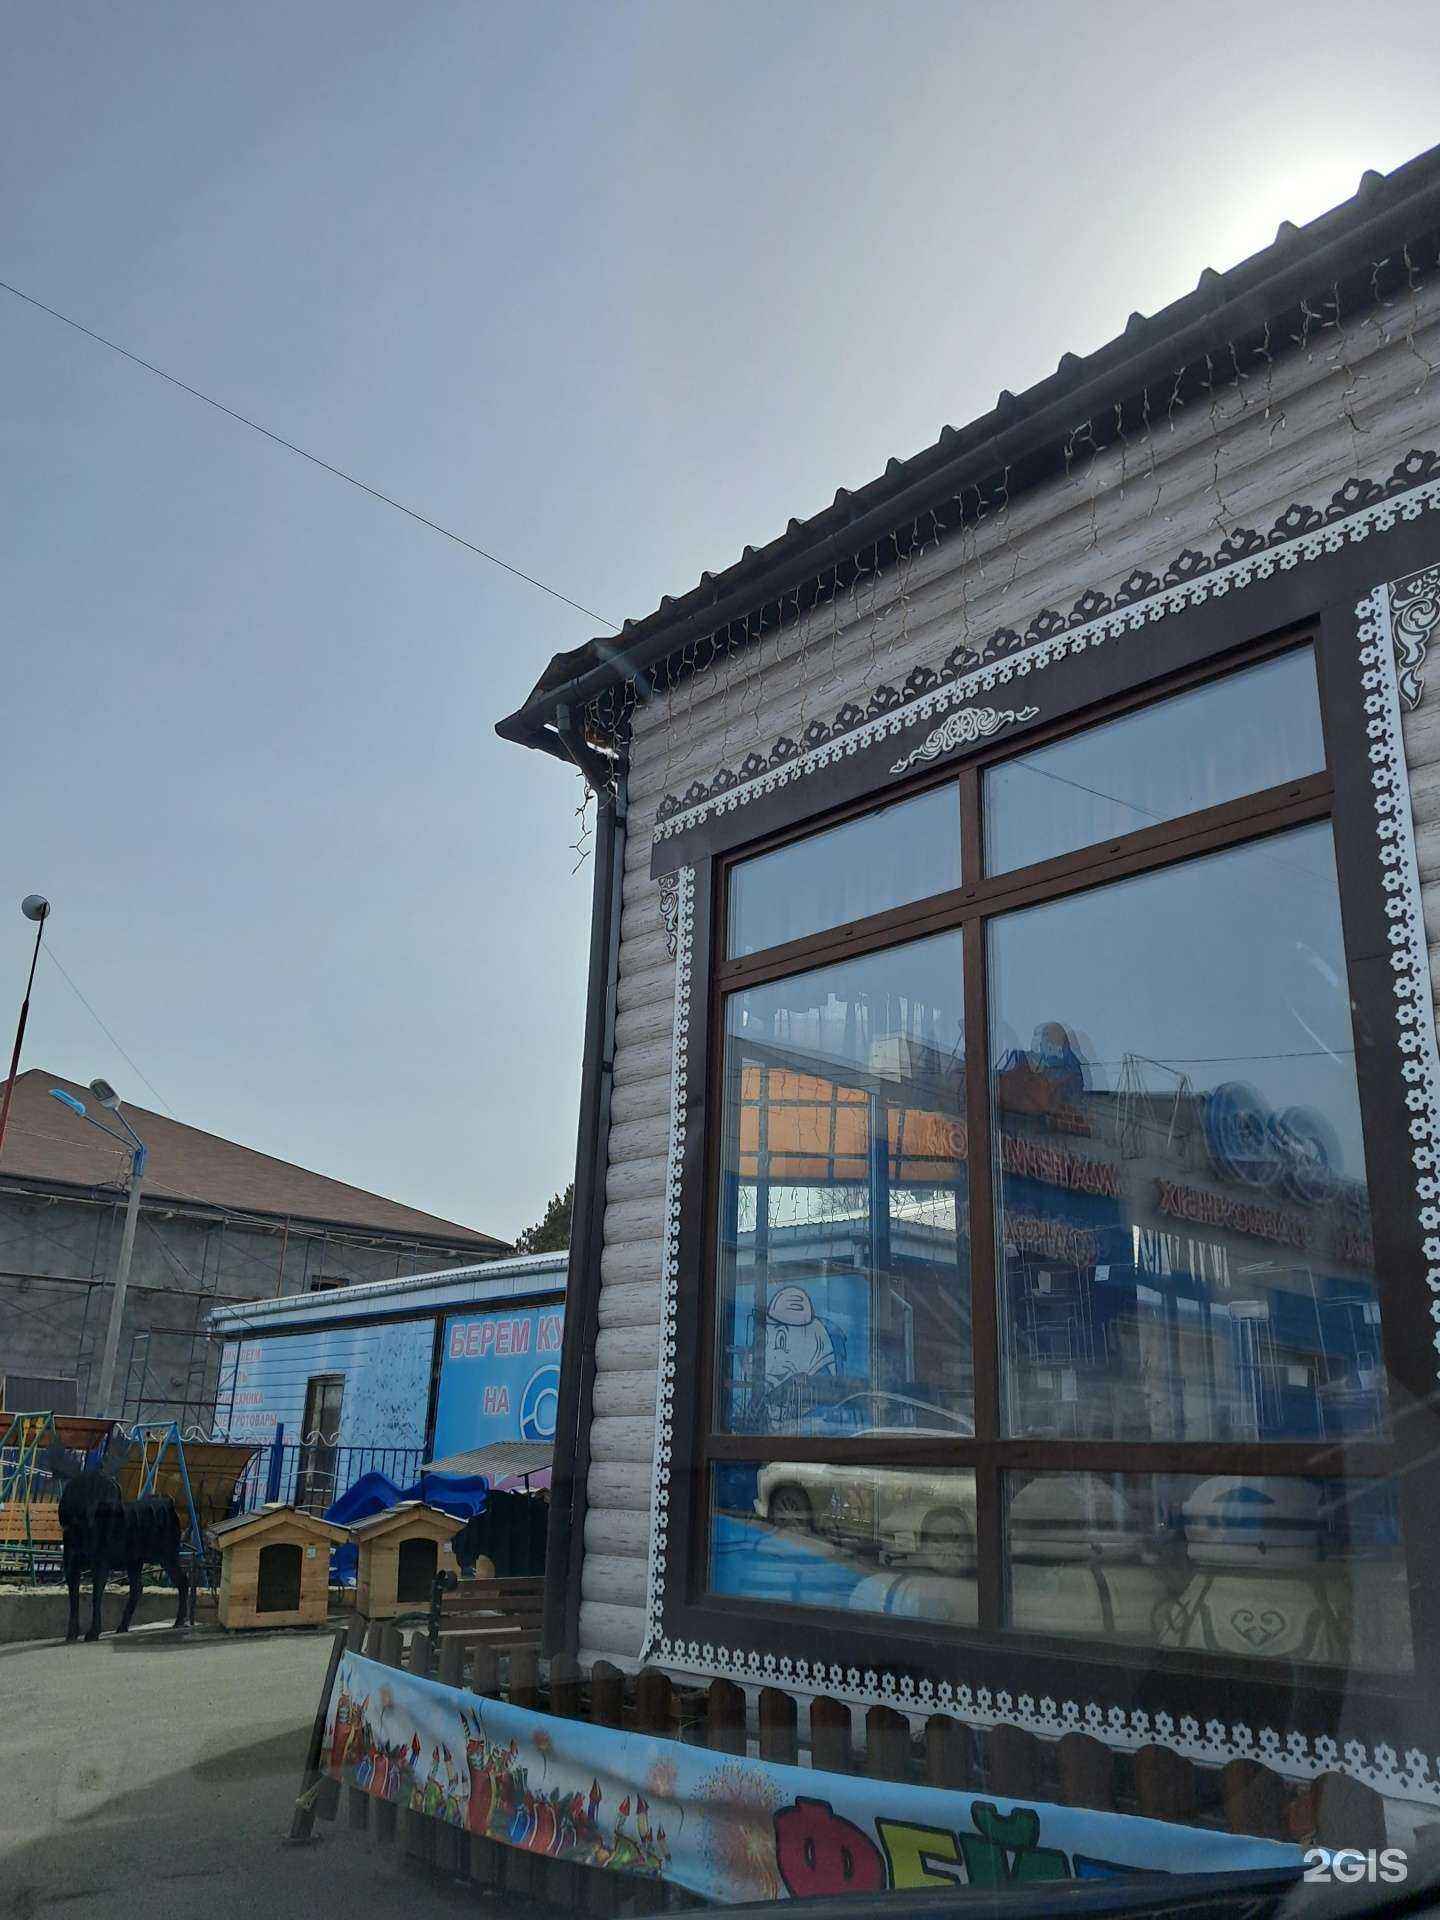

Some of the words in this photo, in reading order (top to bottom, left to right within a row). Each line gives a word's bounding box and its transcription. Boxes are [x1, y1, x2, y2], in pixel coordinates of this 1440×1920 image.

[449, 1318, 531, 1359] БЕРЕМ
[483, 1386, 510, 1415] НА
[215, 1413, 278, 1428] ЭЛЕТРОТОВАРЫ
